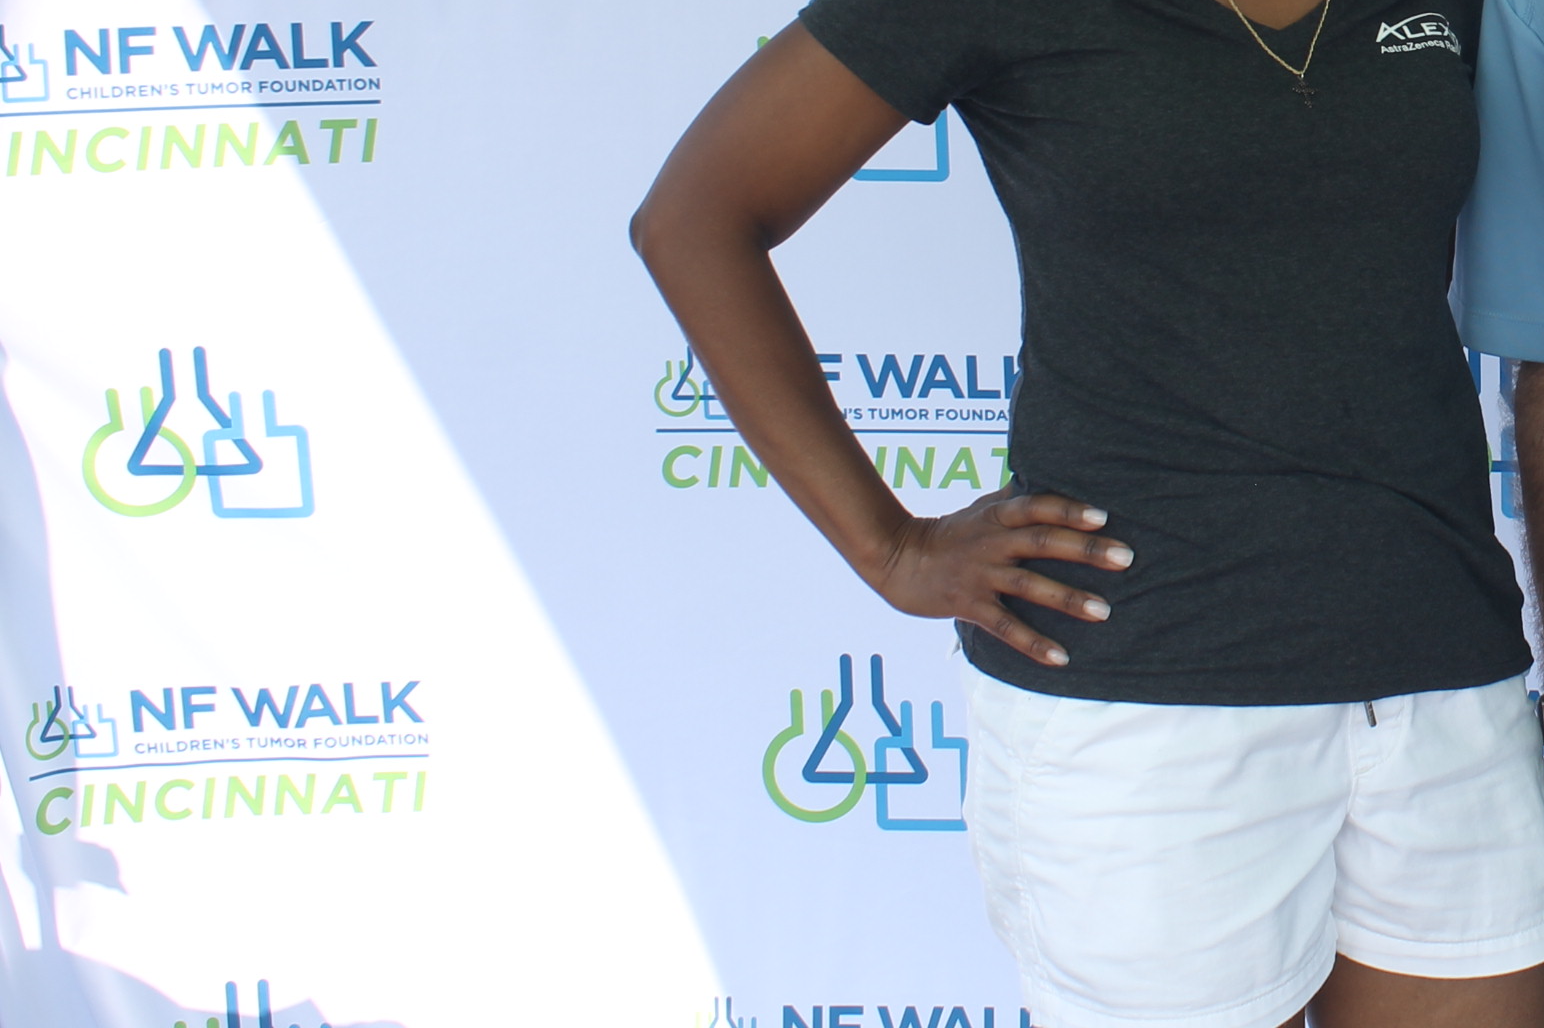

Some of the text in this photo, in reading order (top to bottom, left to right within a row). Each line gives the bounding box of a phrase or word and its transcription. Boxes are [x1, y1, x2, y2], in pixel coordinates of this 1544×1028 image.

[64, 21, 378, 76] NF WALK
[1381, 40, 1444, 54] AstraZeneca
[67, 78, 380, 100] CHILDREN'S TUMOR FOUNDATION
[7, 118, 378, 176] INCINNATI
[870, 408, 928, 420] TUMOR
[130, 681, 424, 732] NF WALK
[134, 733, 429, 755] CHILDREN'S TUMOR FOUNDATION
[36, 771, 426, 836] CINCINNATI
